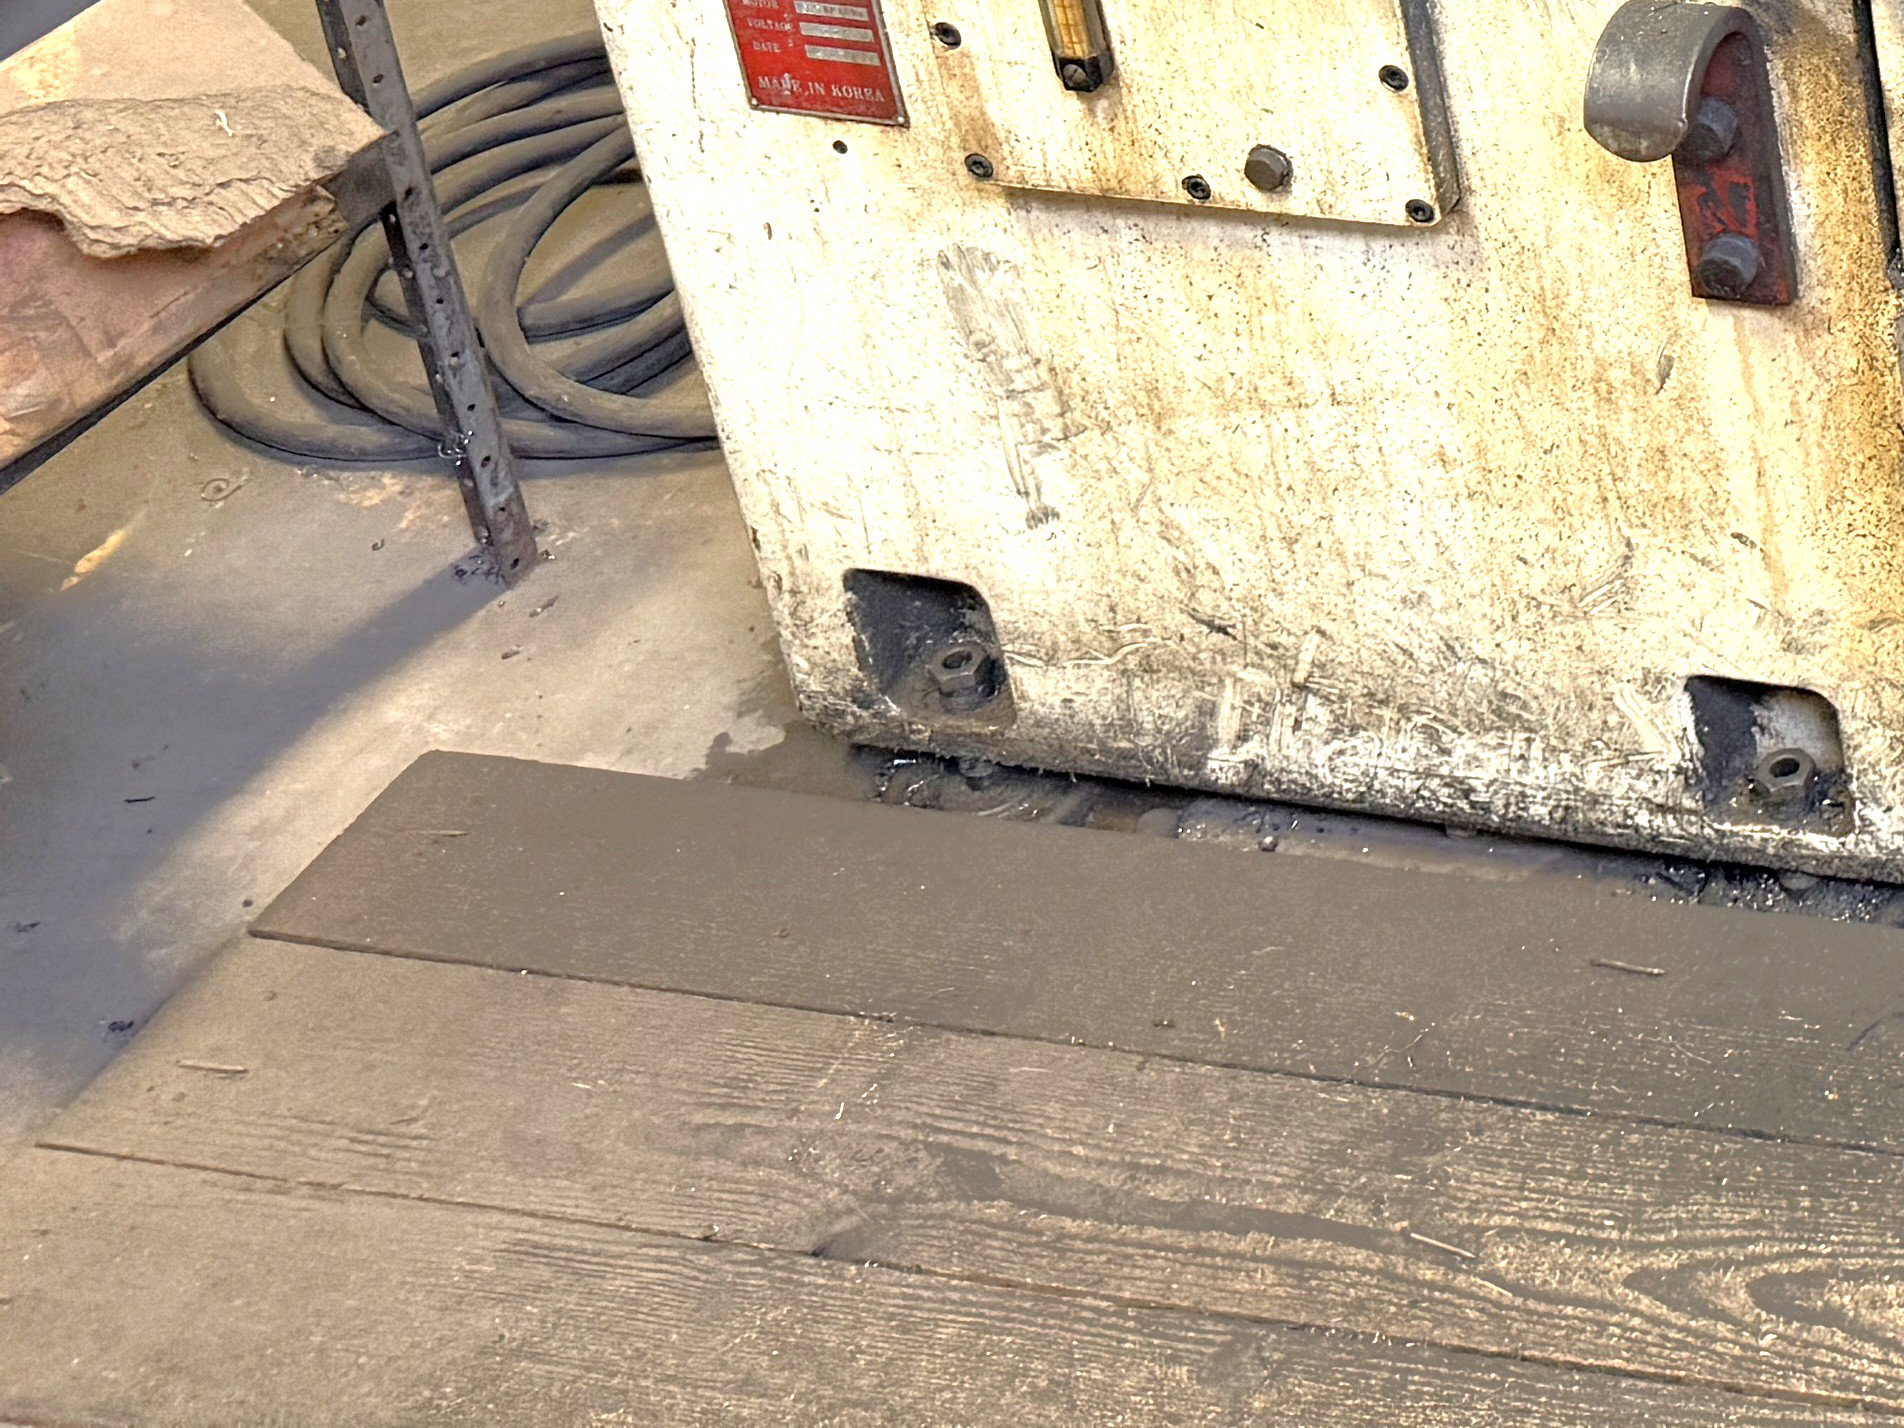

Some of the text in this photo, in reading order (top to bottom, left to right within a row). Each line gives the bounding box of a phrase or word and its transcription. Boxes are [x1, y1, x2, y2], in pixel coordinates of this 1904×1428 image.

[747, 18, 793, 31] VOLTAGE
[753, 41, 781, 53] DATE
[758, 75, 885, 102] MADE IN KOREA
